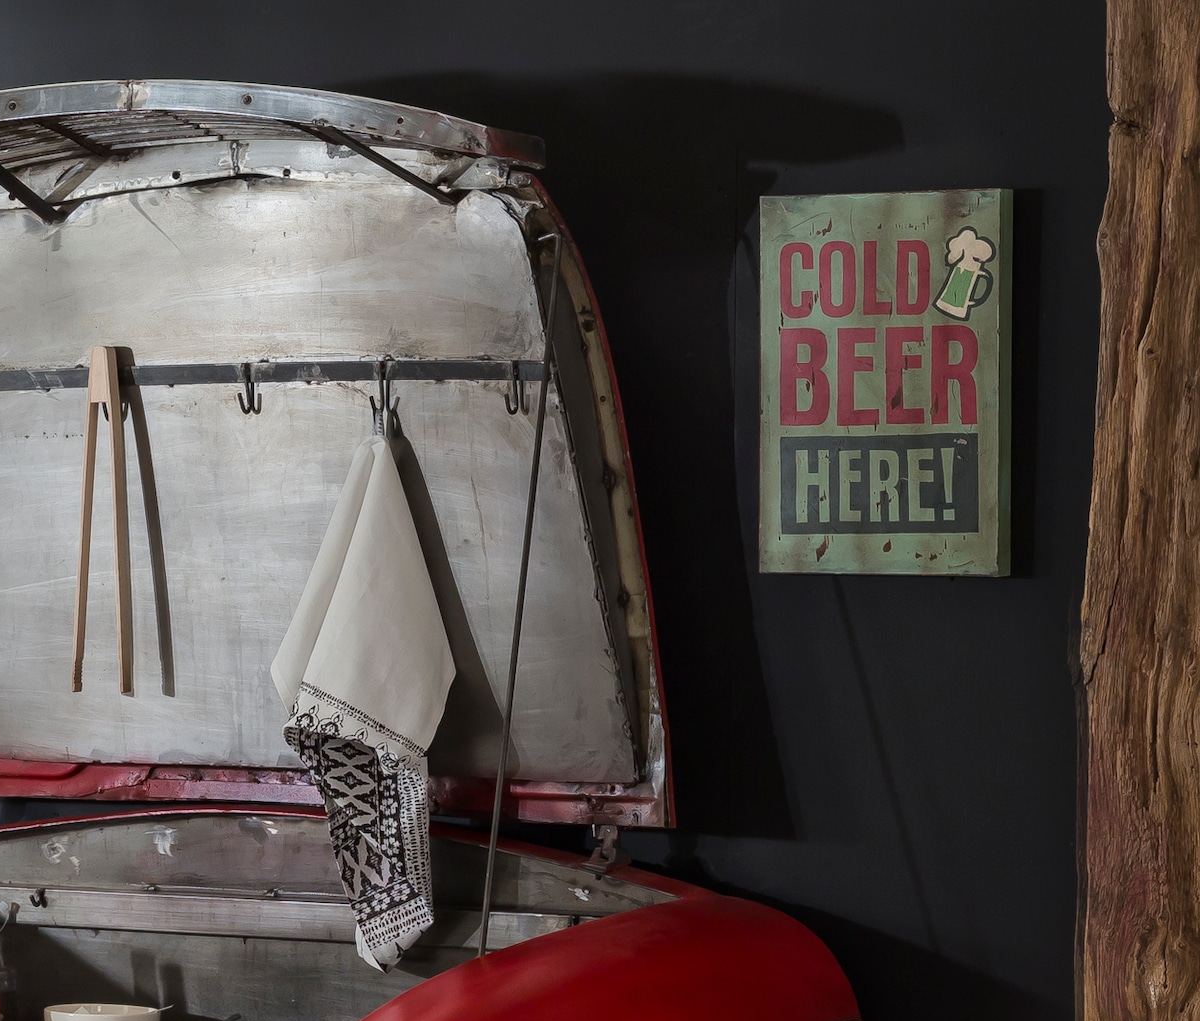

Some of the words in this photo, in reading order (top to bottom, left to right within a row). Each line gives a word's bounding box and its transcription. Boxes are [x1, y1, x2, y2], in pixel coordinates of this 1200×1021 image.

[779, 240, 931, 318] COLD
[779, 325, 979, 426] BEER
[795, 447, 956, 523] HERE!
